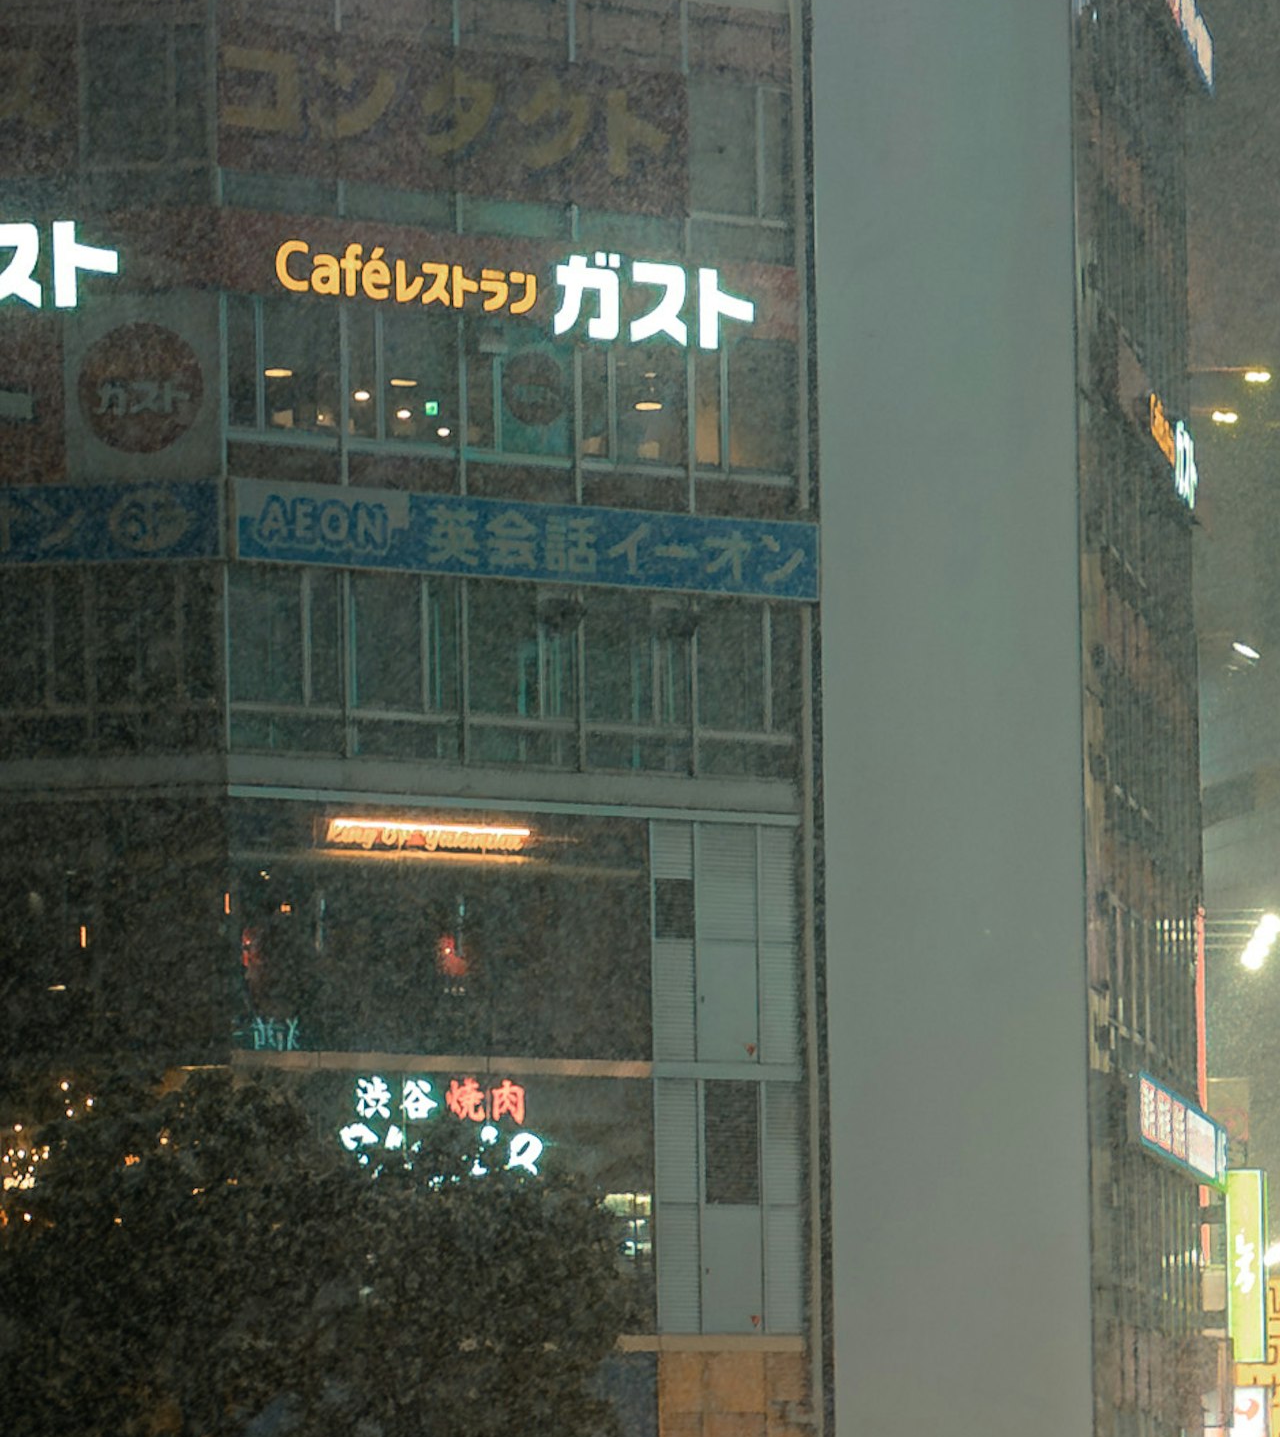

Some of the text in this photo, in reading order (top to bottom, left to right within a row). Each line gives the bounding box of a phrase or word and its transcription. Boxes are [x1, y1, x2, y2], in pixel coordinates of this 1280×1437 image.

[553, 251, 754, 350] ガスト
[258, 494, 390, 555] AEON
[427, 505, 807, 586] 英会話イーオン
